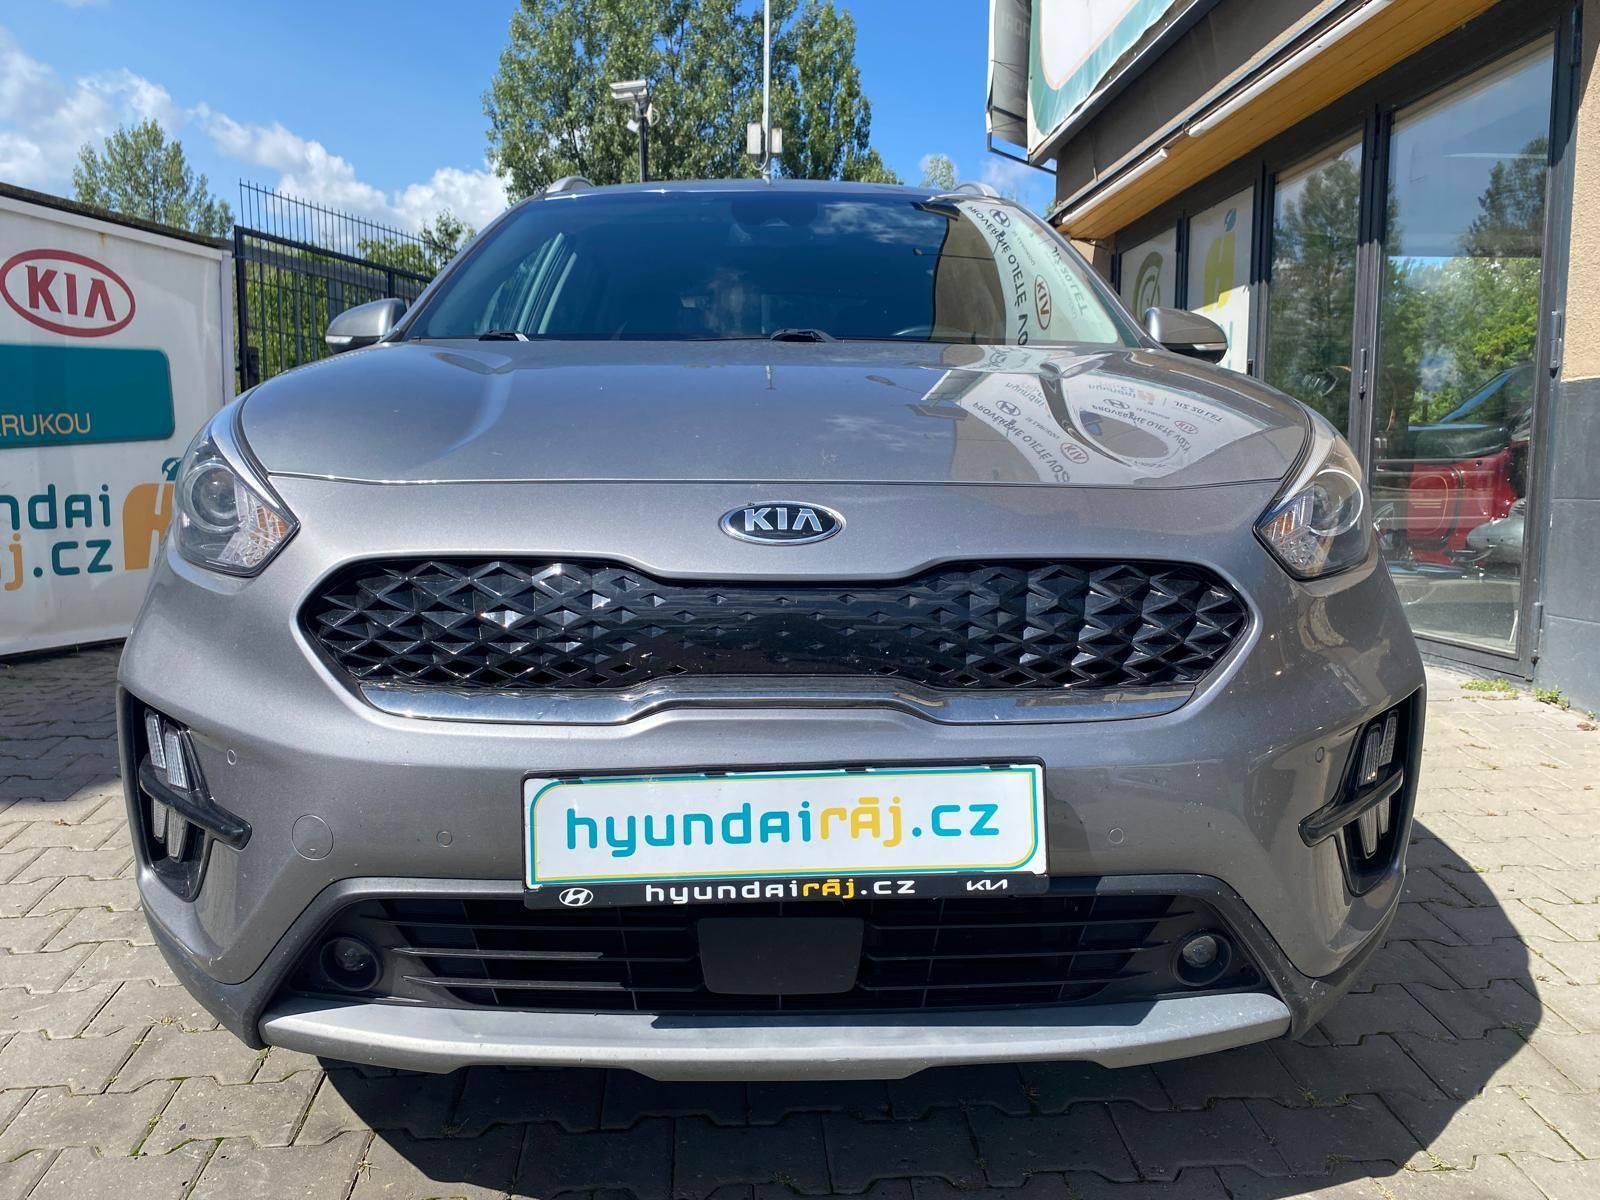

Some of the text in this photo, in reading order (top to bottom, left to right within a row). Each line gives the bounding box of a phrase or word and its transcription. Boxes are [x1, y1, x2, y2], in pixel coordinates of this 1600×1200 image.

[25, 264, 117, 323] KIA
[0, 413, 91, 437] RUKOU
[743, 507, 823, 532] KIA
[0, 532, 113, 591] j.cz
